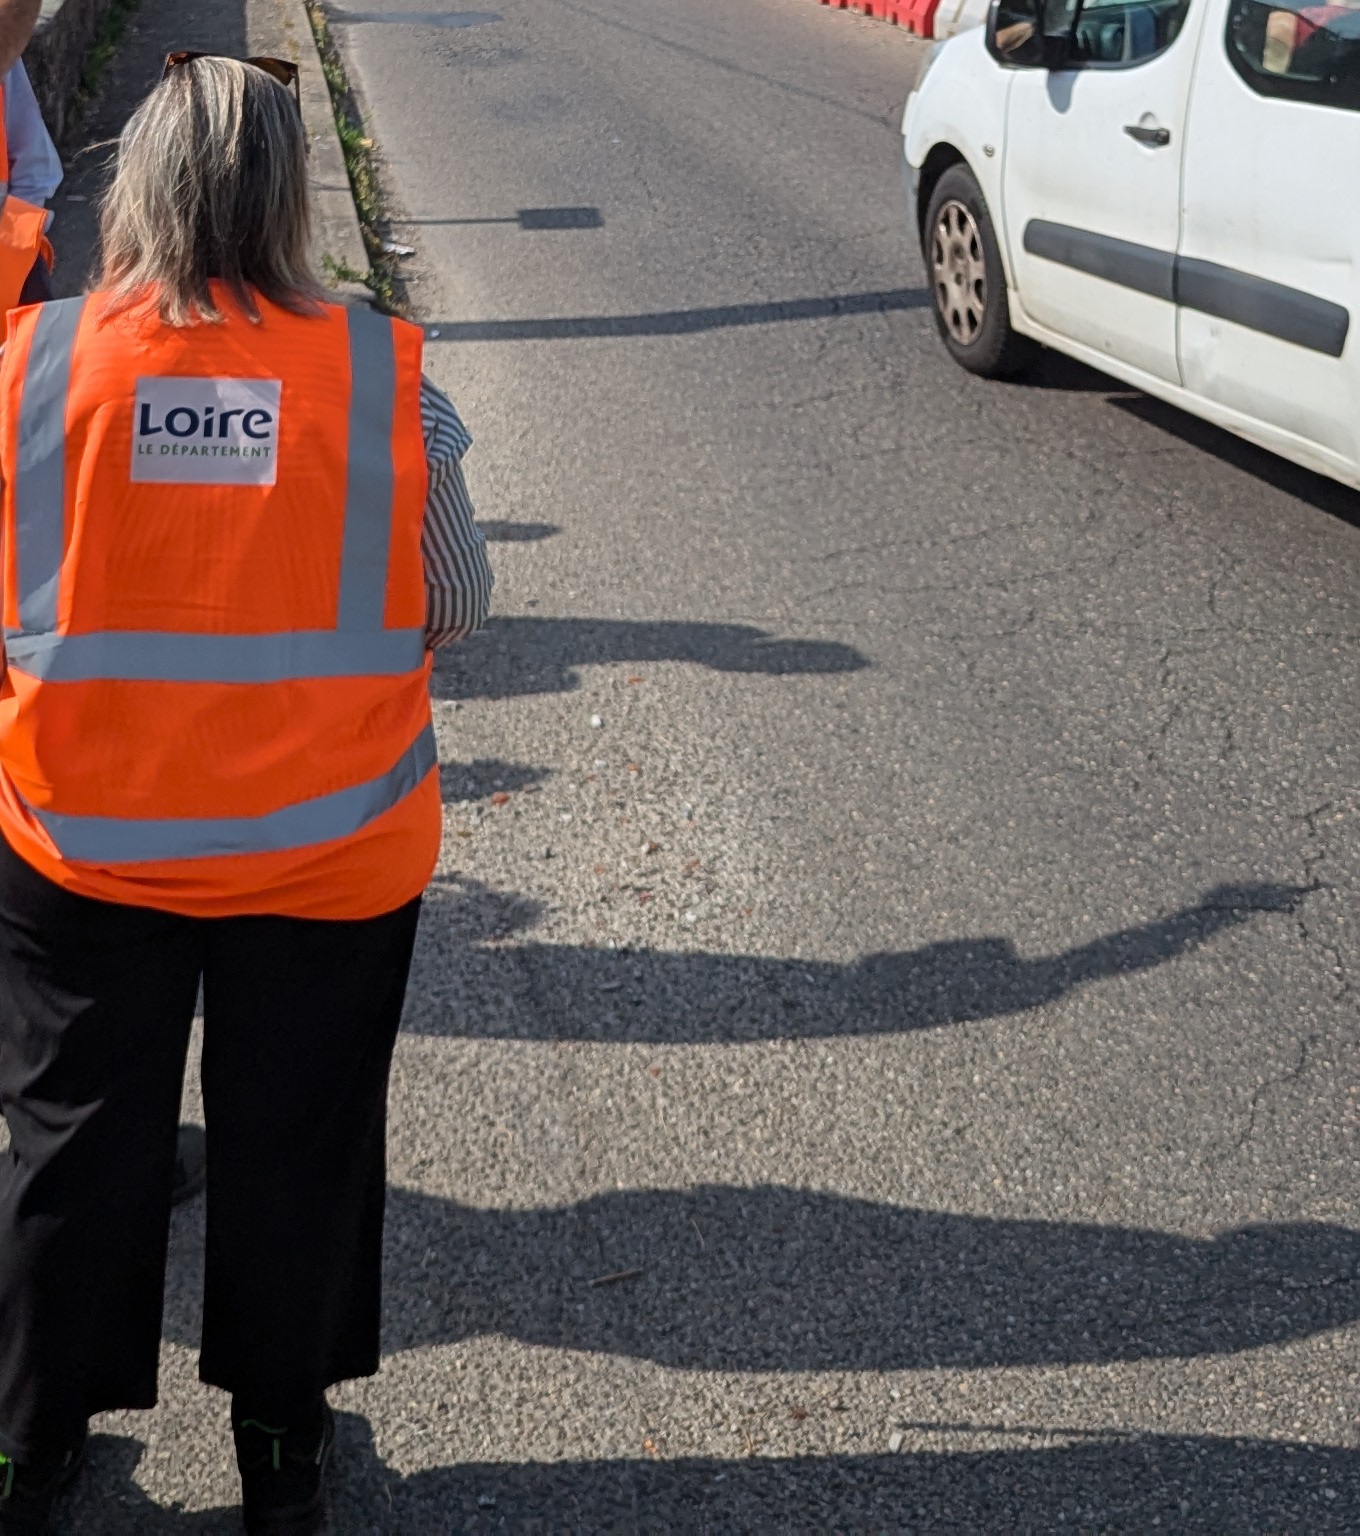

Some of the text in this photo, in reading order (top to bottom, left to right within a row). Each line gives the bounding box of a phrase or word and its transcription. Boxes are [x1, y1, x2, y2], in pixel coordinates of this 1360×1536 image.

[139, 402, 274, 440] Loire
[138, 441, 273, 458] LE DÉPARTEMENT
